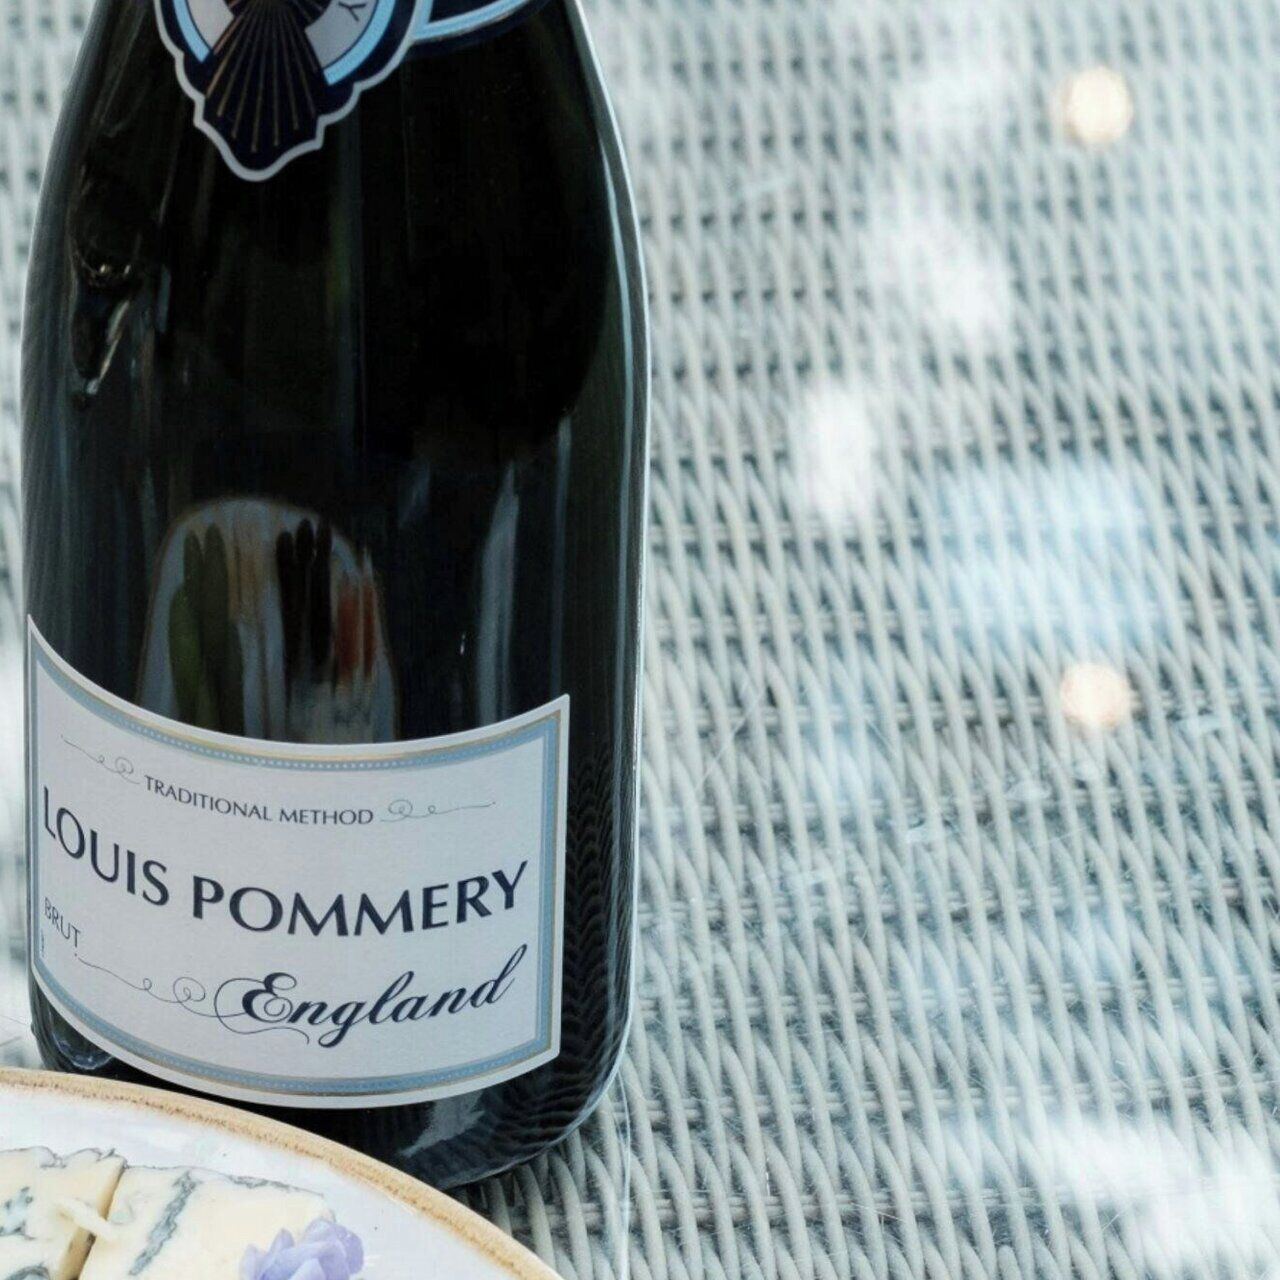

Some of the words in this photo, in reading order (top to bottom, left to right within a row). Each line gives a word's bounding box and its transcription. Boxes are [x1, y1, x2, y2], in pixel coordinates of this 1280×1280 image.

[144, 774, 272, 822] TRADITIONAL
[278, 806, 374, 826] METHOD
[42, 785, 170, 907] LOUIS
[192, 859, 528, 938] POMMERY
[44, 896, 81, 948] BRUT
[240, 943, 528, 1048] England
